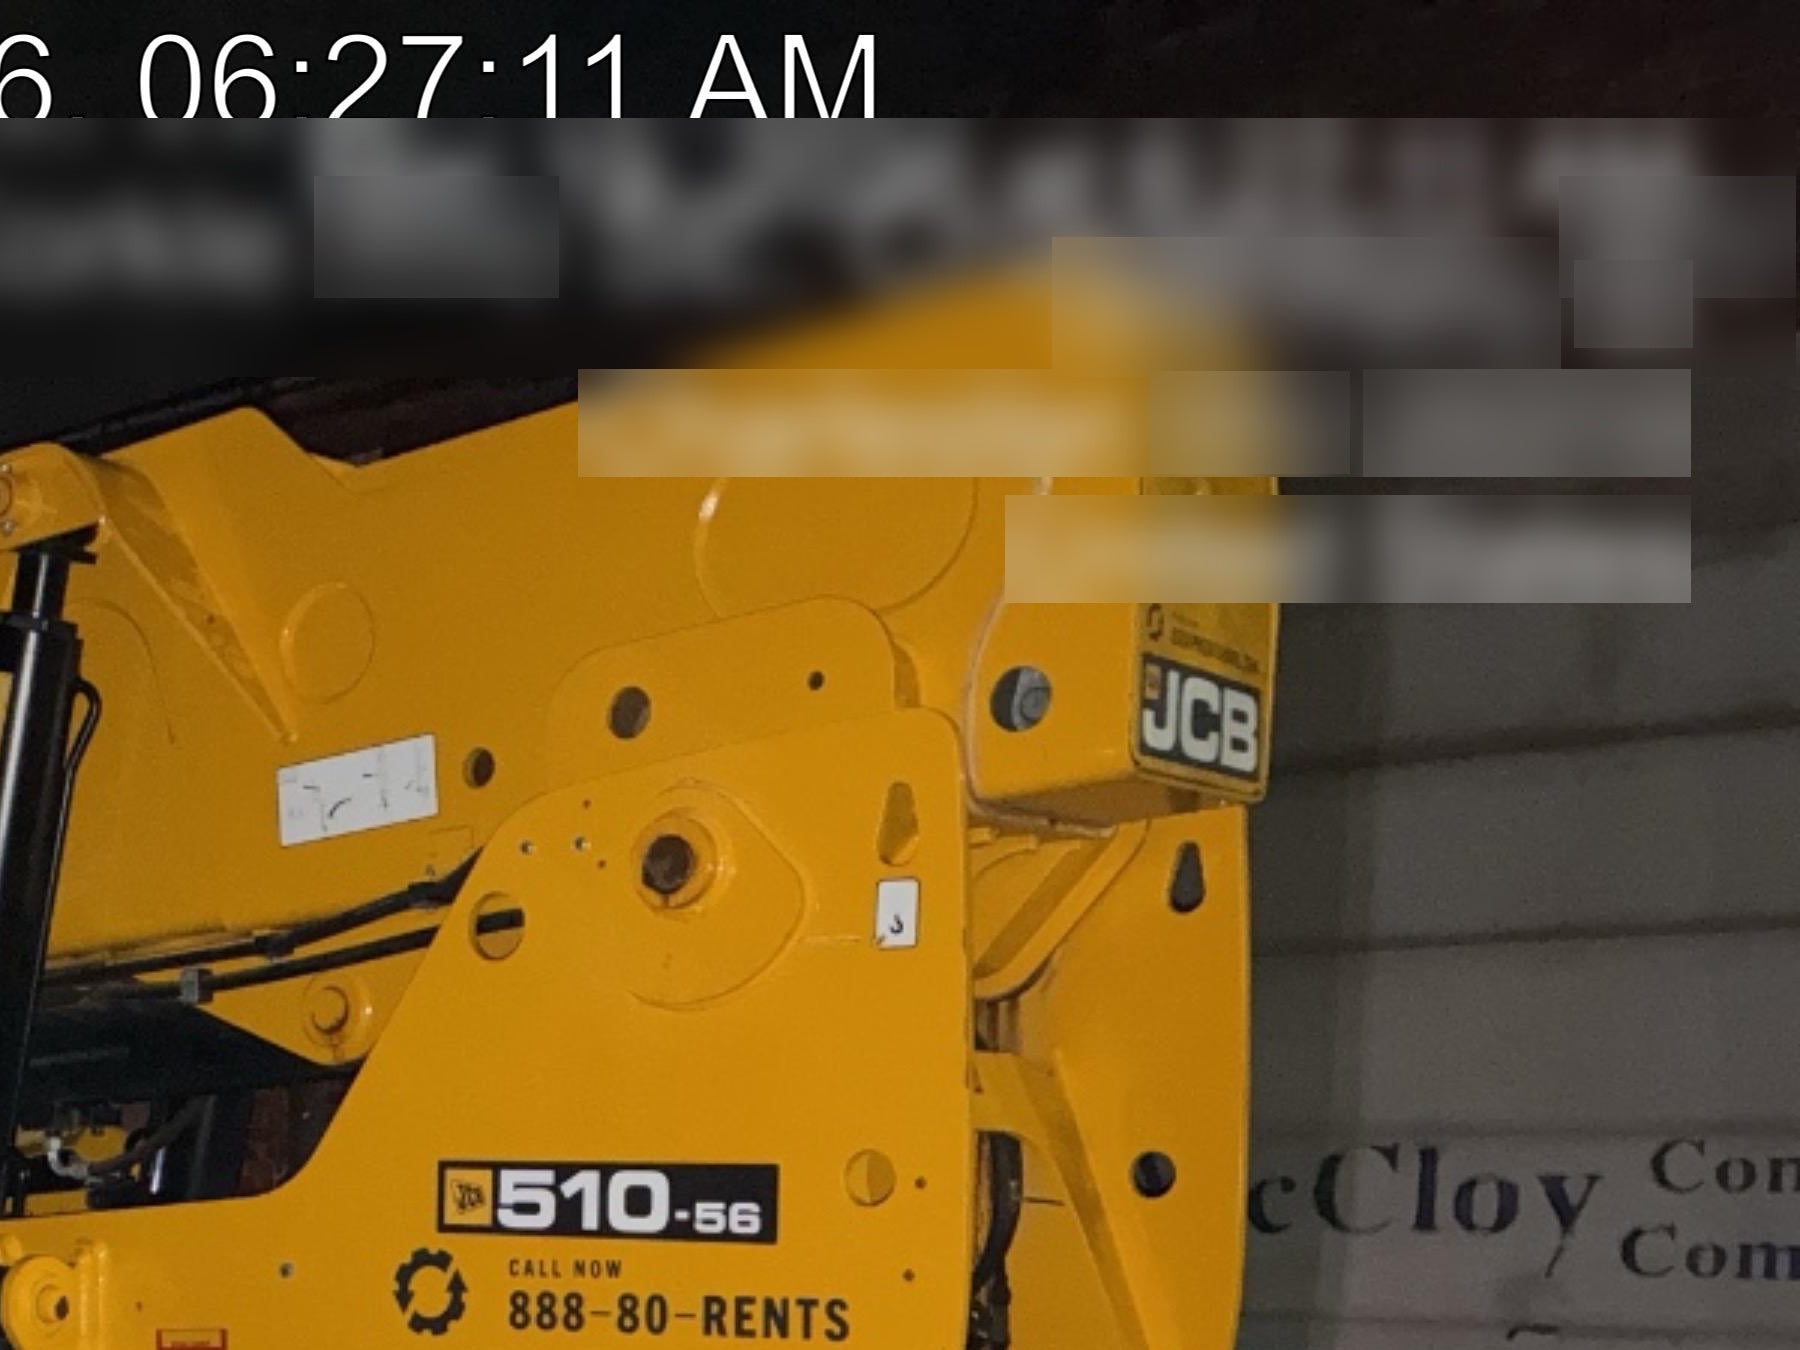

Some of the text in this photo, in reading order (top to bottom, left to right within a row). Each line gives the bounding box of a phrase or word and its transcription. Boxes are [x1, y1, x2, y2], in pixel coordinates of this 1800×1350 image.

[1142, 668, 1259, 774] JCB
[496, 1168, 762, 1236] 510-56
[509, 1259, 622, 1280] CALL NOW
[508, 1289, 851, 1342] 888-80-RENTS
